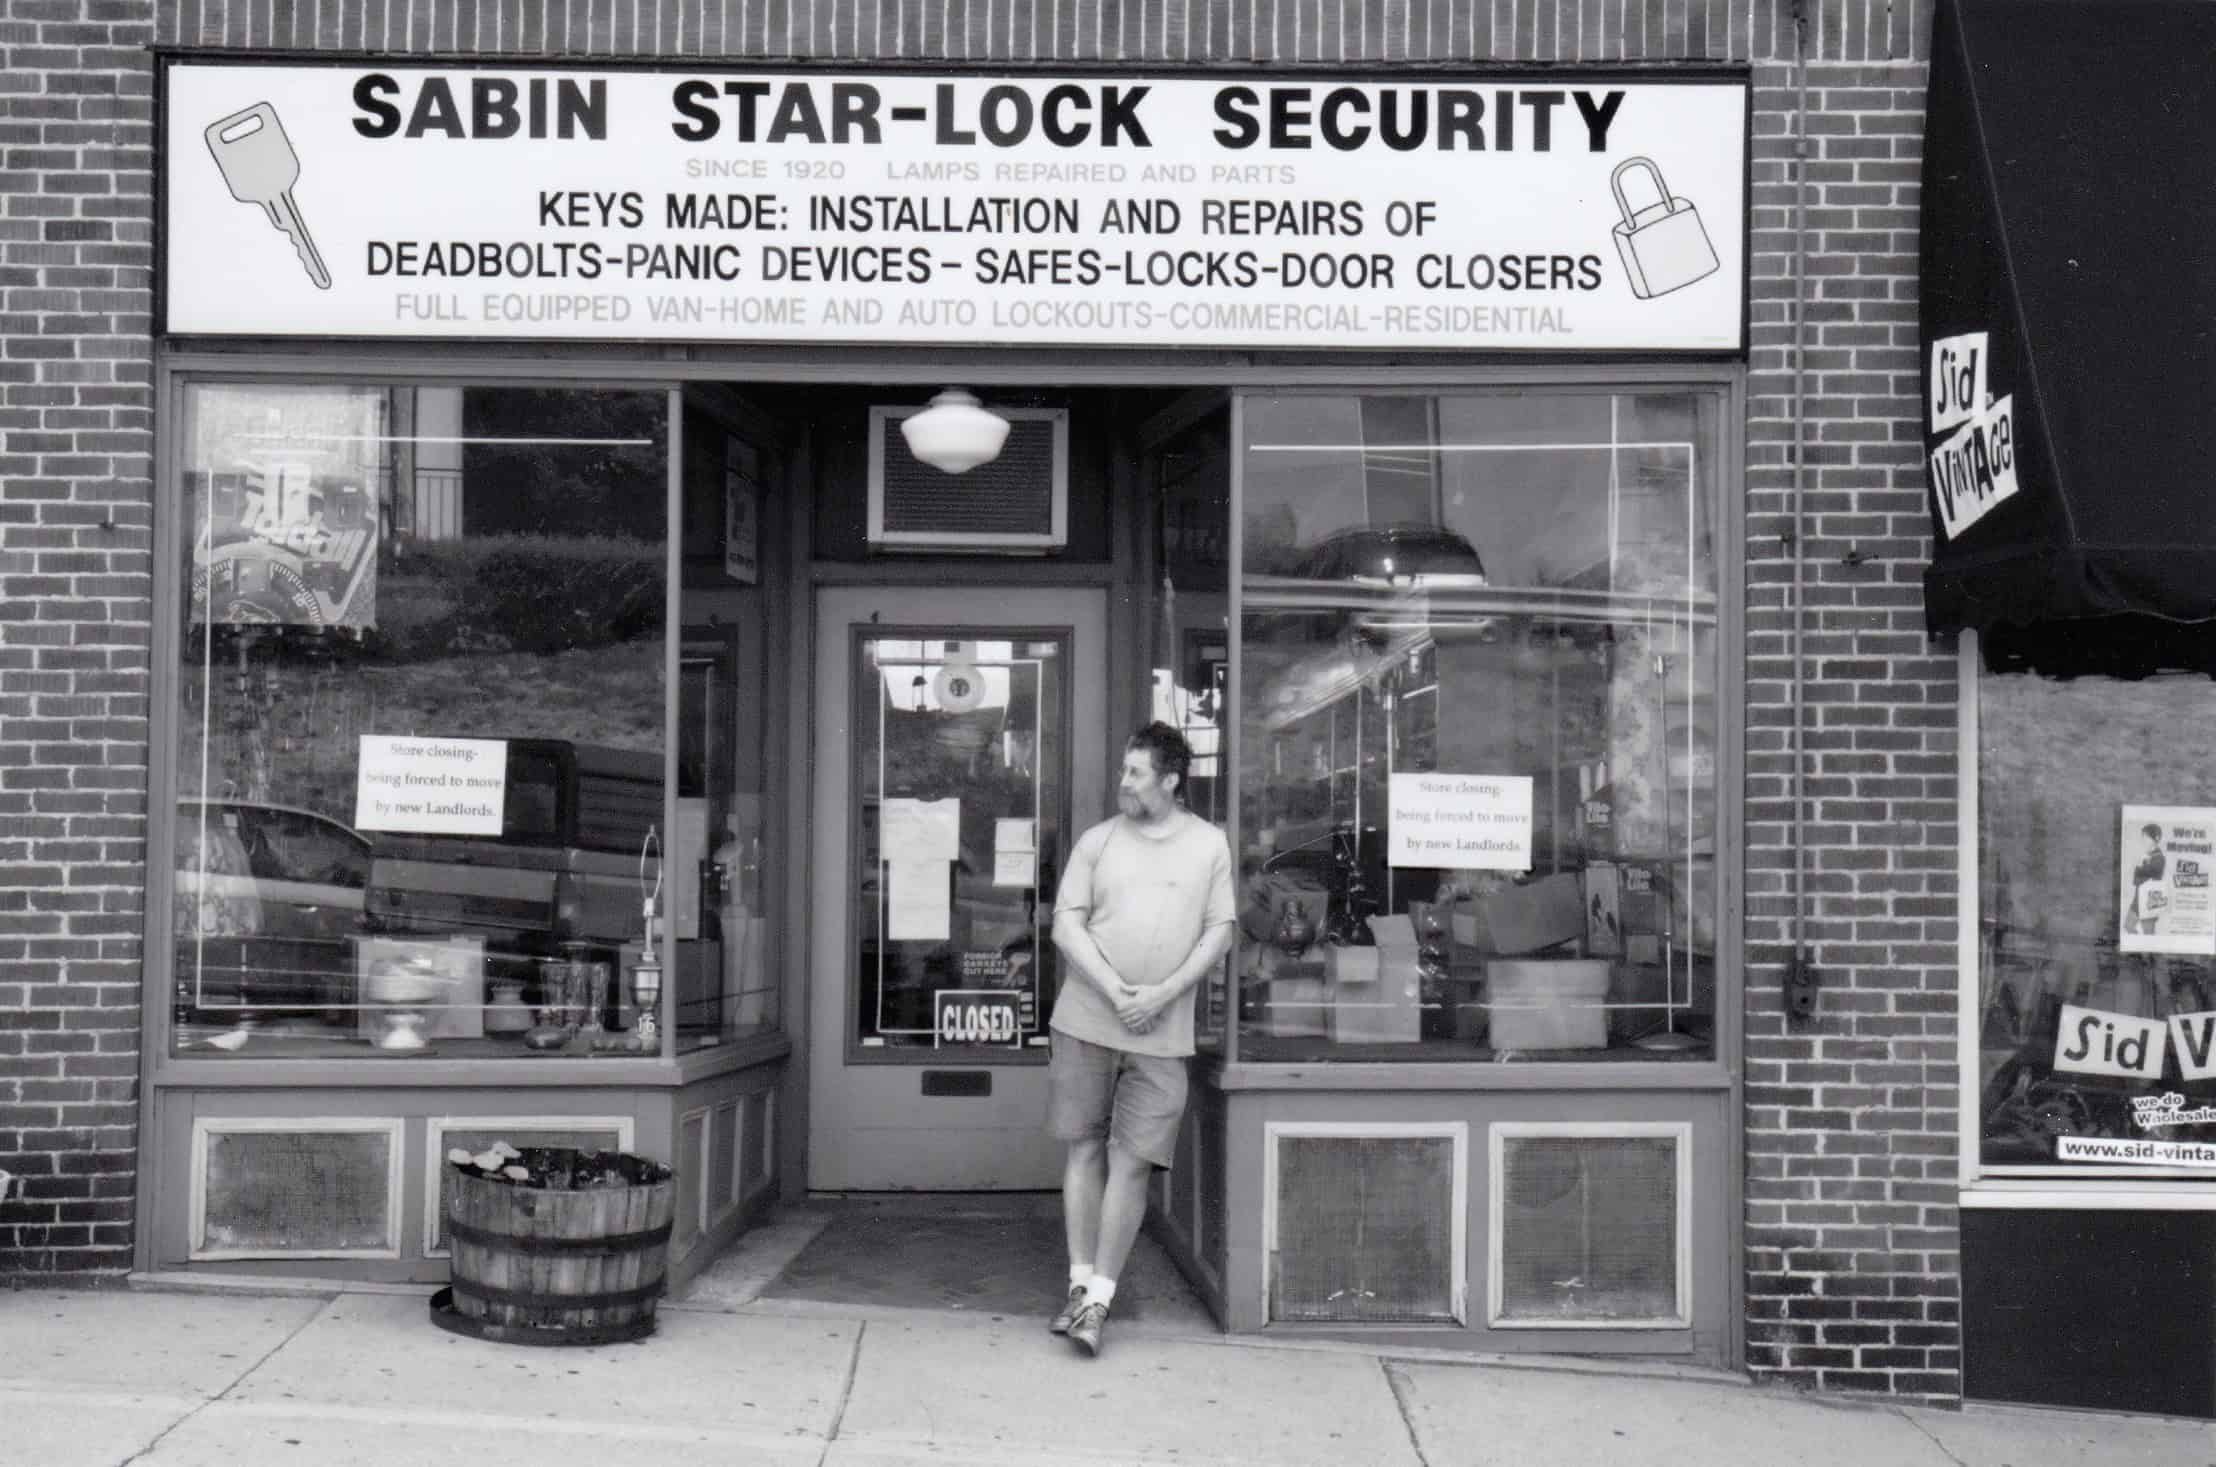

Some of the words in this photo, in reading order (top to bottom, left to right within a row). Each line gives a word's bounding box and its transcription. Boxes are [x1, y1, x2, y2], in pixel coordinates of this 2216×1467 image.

[352, 72, 608, 141] SABIN
[671, 79, 1153, 148] STAR-LOCK
[1213, 84, 1626, 153] SECURITY
[686, 158, 767, 179] SINCE
[784, 160, 846, 180] 1920
[887, 161, 980, 181] LAMPS
[995, 162, 1127, 183] REPAIRED
[1141, 164, 1197, 184] AND
[1211, 164, 1296, 185] PARTS
[539, 191, 644, 229] KEYS
[666, 193, 787, 231] MADE:
[810, 195, 1079, 234] INSTALLATION
[1099, 198, 1181, 235] AND
[1202, 199, 1364, 237] REPAIRS
[1385, 201, 1436, 237] OF
[367, 241, 741, 281] DEADBOLTS-PANIC
[975, 247, 1394, 289] SAFES-LOCKS-DOOR
[1416, 253, 1602, 291] CLOSERS
[395, 292, 468, 321] FULL
[483, 293, 631, 324] EQUIPPED
[648, 295, 806, 326] VAN-HOME
[822, 298, 883, 325] AND
[898, 299, 977, 327] AUTO
[992, 300, 1573, 334] LOCKOUTS-COMMERCIAL-RESIDENTIAL
[1937, 348, 1978, 414] Sid
[391, 743, 424, 756] Store
[405, 772, 446, 786] forced
[450, 774, 463, 787] to
[467, 776, 502, 788] move
[1419, 781, 1452, 793] Store
[376, 800, 390, 816] by
[395, 804, 422, 815] new
[1395, 808, 1431, 823] being
[1434, 809, 1474, 822] forced
[1477, 811, 1490, 823] to
[1494, 814, 1529, 823] move
[1407, 836, 1421, 852] by
[1425, 840, 1451, 849] new
[942, 1004, 1014, 1041] CLOSED
[2063, 1015, 2149, 1071] Sid
[2135, 1098, 2158, 1108] we
[2163, 1093, 2183, 1106] do
